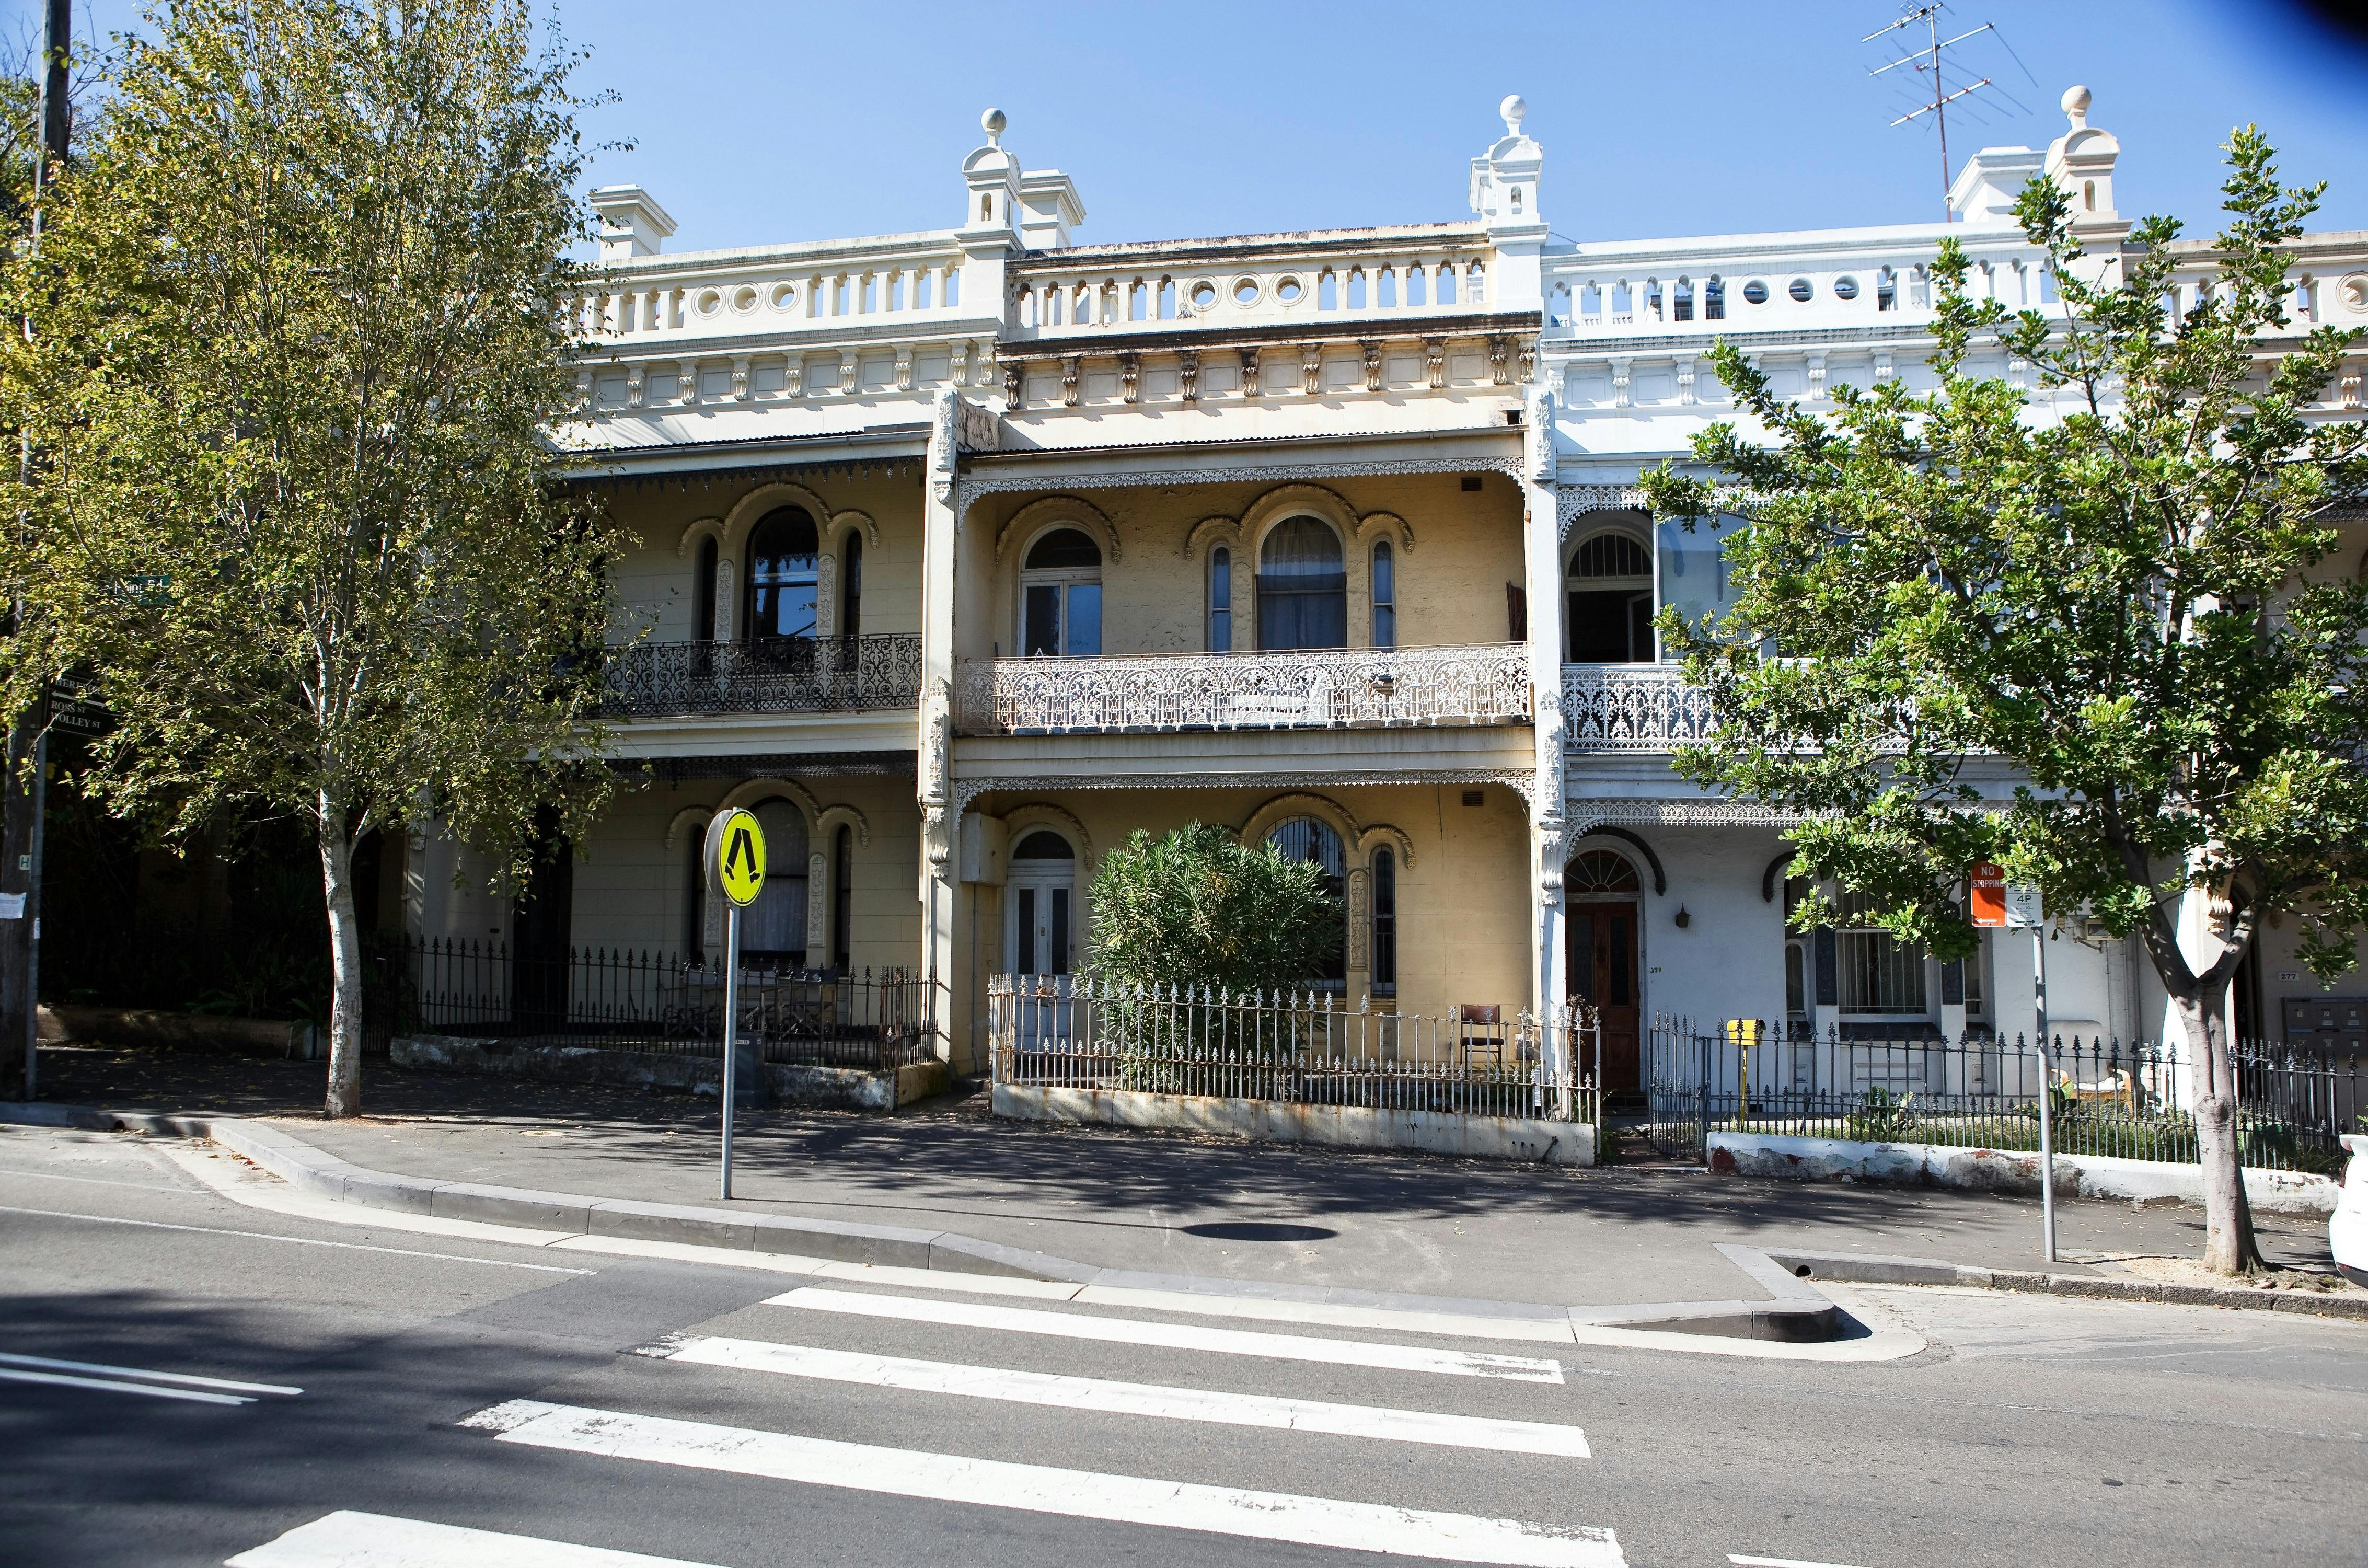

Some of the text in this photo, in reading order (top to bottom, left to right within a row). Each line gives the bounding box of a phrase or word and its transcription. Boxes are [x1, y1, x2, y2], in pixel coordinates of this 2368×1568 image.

[51, 700, 75, 713] ROSS
[21, 857, 29, 868] H
[1981, 866, 1994, 876] NO
